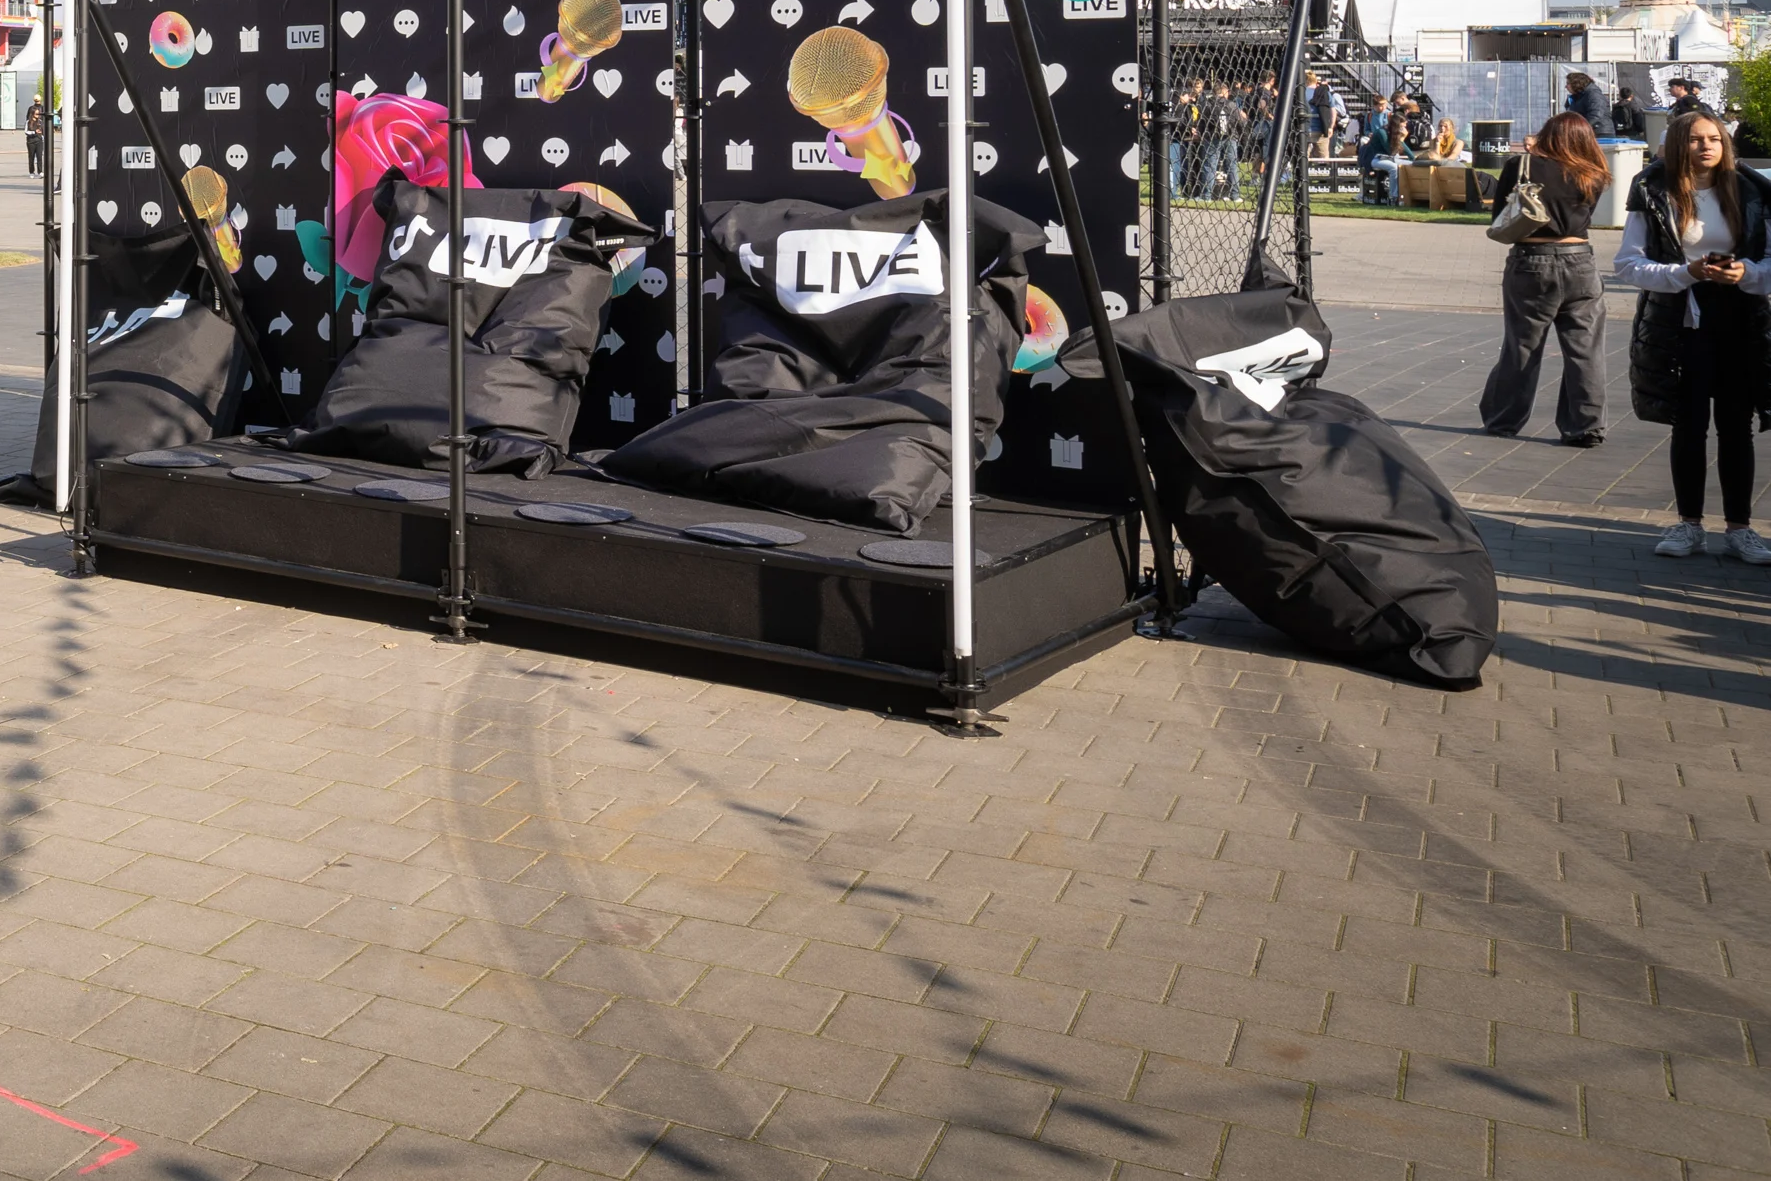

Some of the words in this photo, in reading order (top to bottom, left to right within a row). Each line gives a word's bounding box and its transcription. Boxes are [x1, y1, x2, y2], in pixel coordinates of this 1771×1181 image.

[625, 9, 661, 24] LIVE
[291, 30, 320, 44] LIVE
[934, 74, 978, 90] LIE
[209, 92, 236, 105] LIVE
[126, 151, 151, 164] LIVE
[795, 238, 920, 294] LIVE
